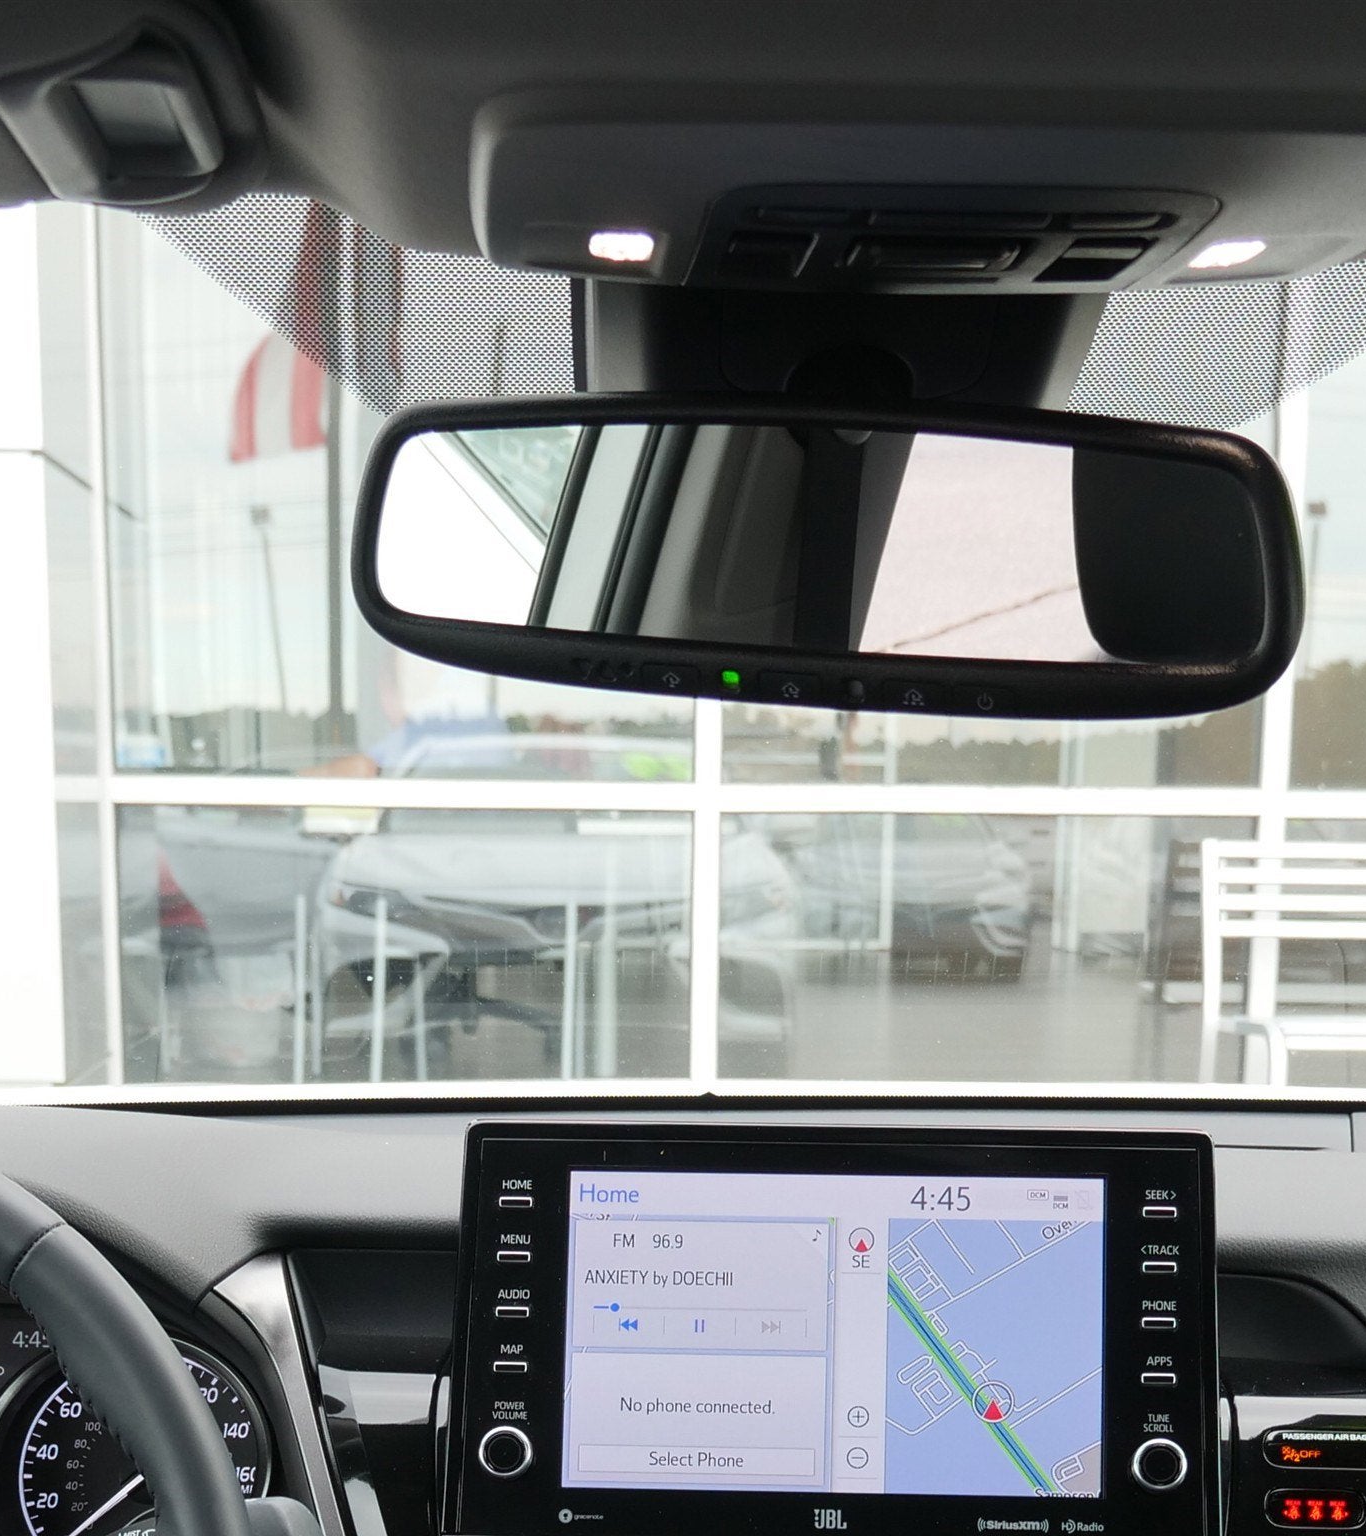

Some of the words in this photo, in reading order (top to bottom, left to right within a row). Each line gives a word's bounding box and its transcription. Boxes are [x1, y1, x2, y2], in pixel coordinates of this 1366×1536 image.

[502, 1180, 533, 1190] HOME
[579, 1183, 640, 1203] Home
[910, 1186, 971, 1212] 4:45
[501, 1234, 531, 1245] MENU
[613, 1234, 635, 1248] FM
[652, 1234, 684, 1249] 96.9
[1147, 1245, 1179, 1255] TRACK
[851, 1255, 870, 1269] SE
[585, 1270, 648, 1285] ANXIETY
[653, 1270, 668, 1288] by
[673, 1271, 733, 1287] DOECHII
[497, 1289, 531, 1299] AUDIO
[1142, 1301, 1177, 1311] PHONE
[500, 1344, 523, 1354] MAP
[1146, 1356, 1172, 1367] APPS
[60, 1402, 82, 1418] 60
[494, 1401, 525, 1410] POWER
[620, 1397, 642, 1413] No
[646, 1398, 691, 1415] phone
[696, 1398, 775, 1415] connected.
[492, 1411, 528, 1420] VOLUME
[1147, 1414, 1170, 1423] TUNE
[85, 1422, 101, 1432] 100
[223, 1423, 249, 1438] 140
[1143, 1424, 1174, 1433] SCROLL
[74, 1439, 88, 1449] 80
[37, 1444, 58, 1460] 40
[1300, 1450, 1320, 1458] OFF
[66, 1460, 80, 1469] 60
[649, 1452, 693, 1467] Select
[698, 1452, 744, 1468] Phone
[65, 1481, 78, 1490] 40
[36, 1493, 58, 1508] 20
[71, 1502, 84, 1511] 20
[814, 1509, 847, 1530] JBL
[1077, 1522, 1105, 1531] Radio
